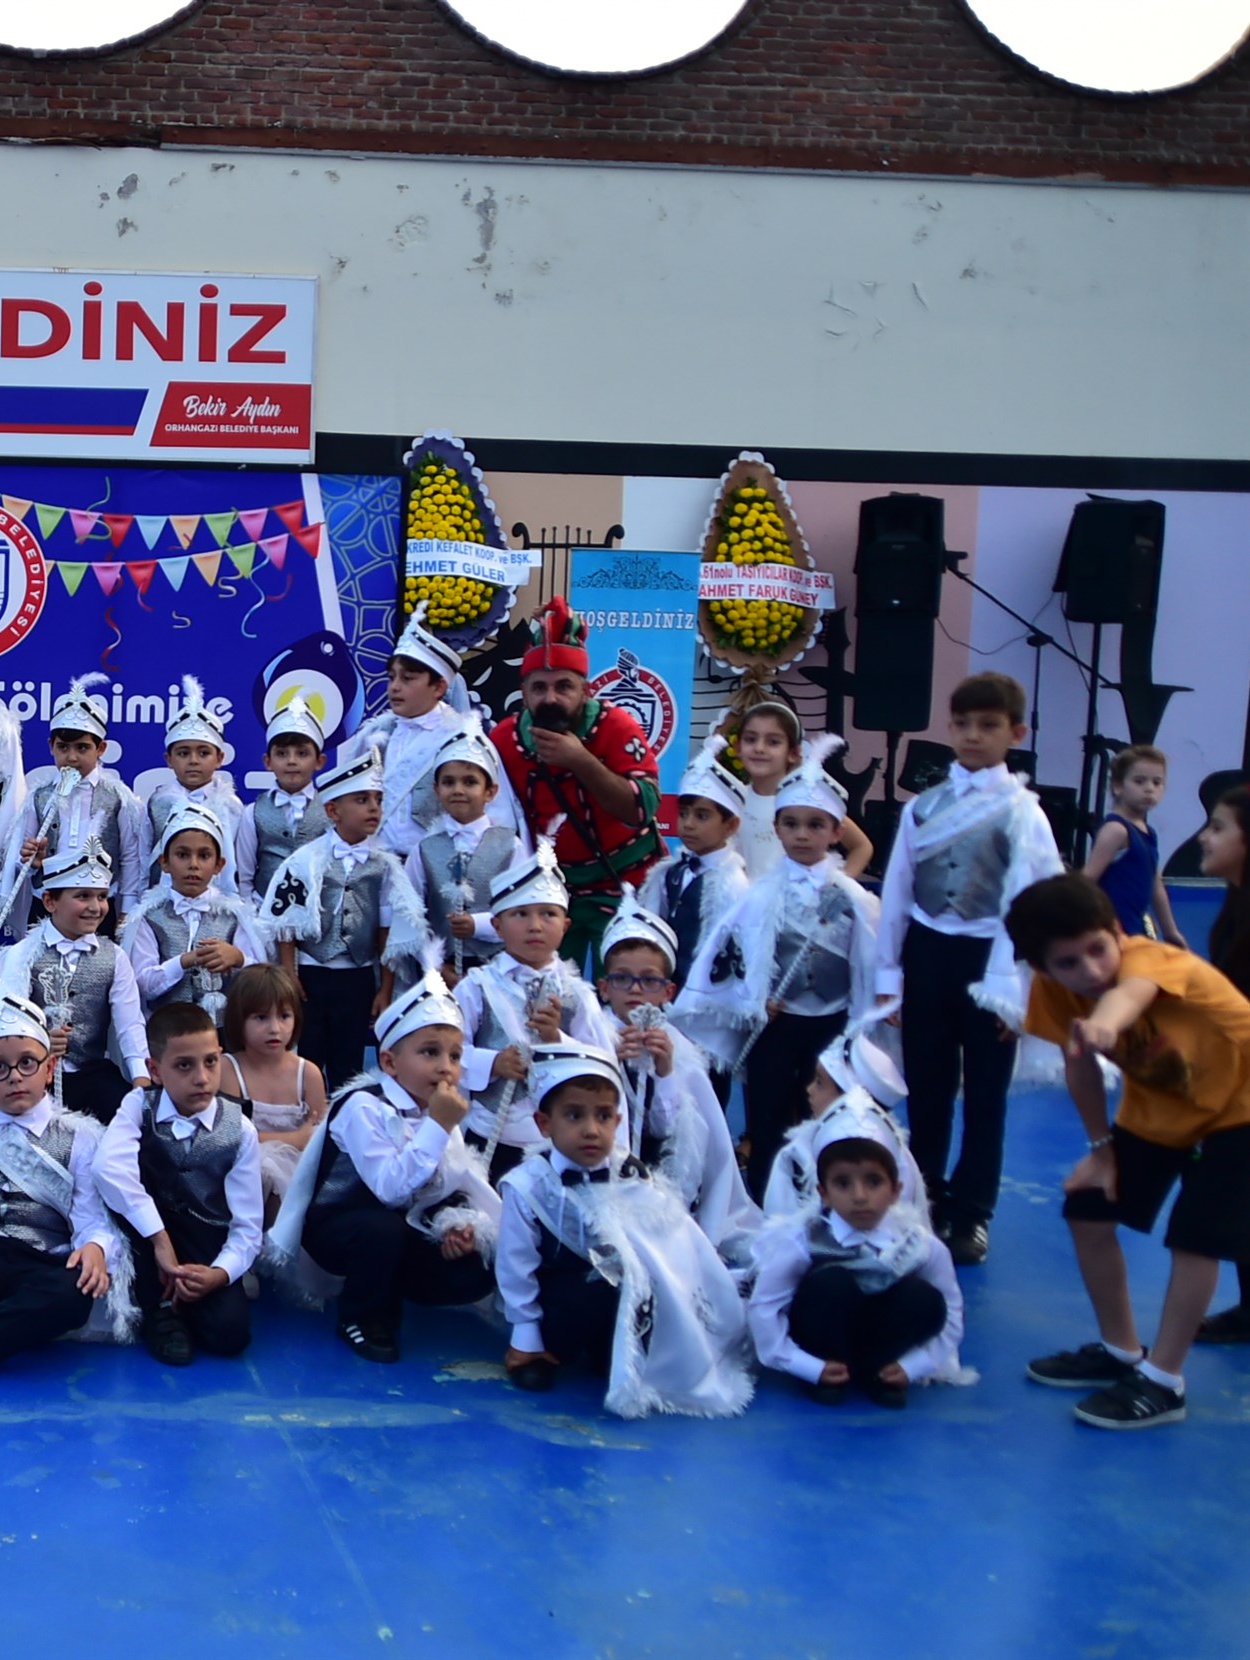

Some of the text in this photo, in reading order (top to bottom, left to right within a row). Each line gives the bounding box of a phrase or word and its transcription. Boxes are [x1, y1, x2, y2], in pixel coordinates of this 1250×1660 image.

[183, 395, 281, 425] Bekir Aydın
[436, 541, 473, 556] KEFALET
[499, 555, 509, 565] ve
[462, 561, 506, 582] GÜLER
[699, 583, 745, 598] AHMET
[748, 584, 788, 600] FARUK
[647, 676, 672, 751] BELEDİYES
